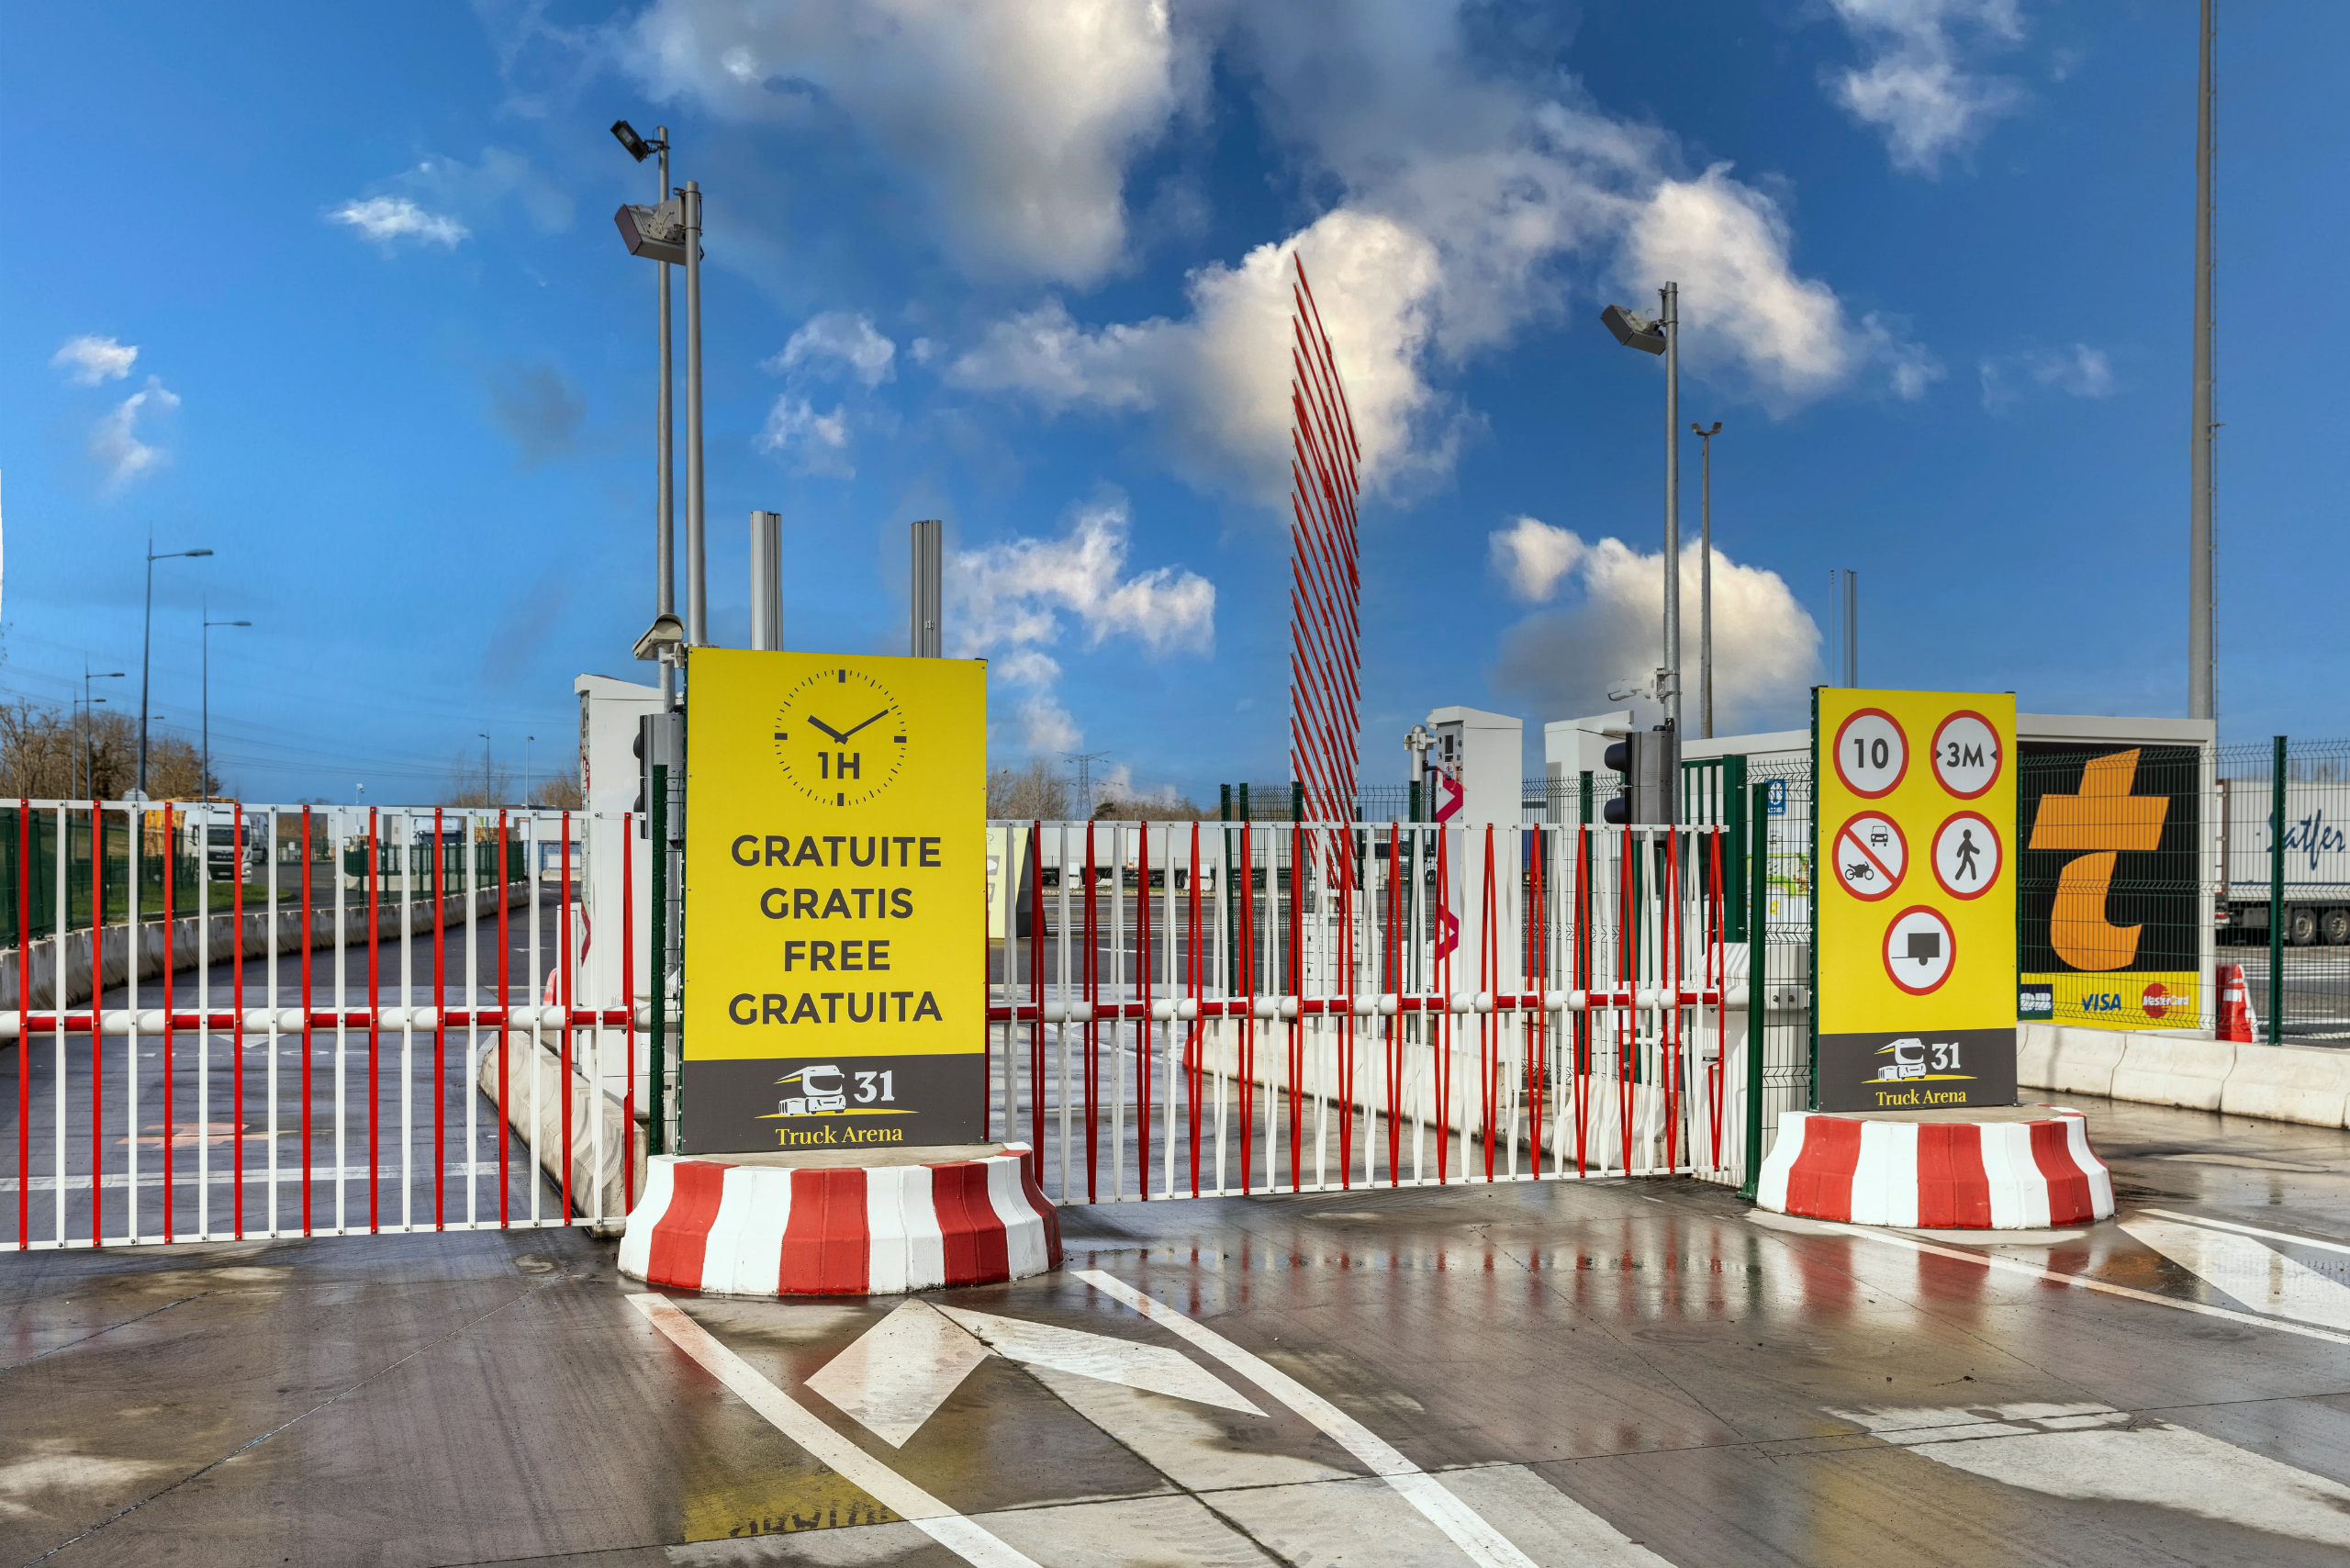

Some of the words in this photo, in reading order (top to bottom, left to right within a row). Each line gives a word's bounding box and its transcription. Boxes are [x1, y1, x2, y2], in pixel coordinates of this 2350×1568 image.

[817, 751, 860, 780] 1H
[1854, 738, 1889, 769] 10
[1946, 742, 1985, 768] 3M
[731, 834, 942, 868] GRATUITE
[760, 887, 913, 920] GRATIS
[784, 939, 890, 972] FREE
[728, 991, 943, 1025] GRATUITA
[2081, 993, 2122, 1011] VISA
[2143, 995, 2189, 1006] MasterCard
[1930, 1042, 1961, 1070] 31
[854, 1070, 895, 1103] 31
[1875, 1089, 1920, 1106] Truck
[1922, 1090, 1967, 1103] Arena
[775, 1126, 838, 1146] Truck
[841, 1126, 903, 1143] Arena
